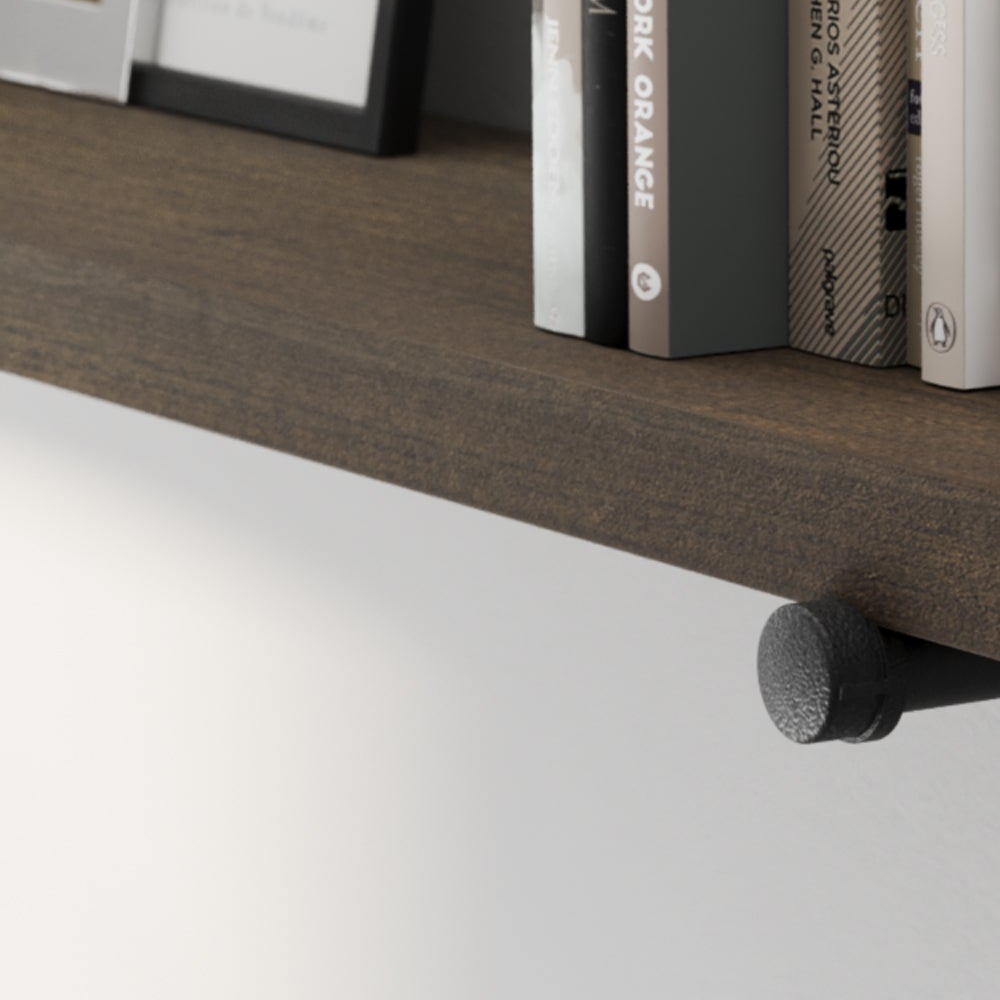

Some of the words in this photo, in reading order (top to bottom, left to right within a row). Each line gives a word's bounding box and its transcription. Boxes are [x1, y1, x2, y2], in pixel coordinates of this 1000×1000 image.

[633, 74, 655, 211] ORANGE
[810, 77, 823, 142] HALL
[826, 62, 842, 187] ASTERIOU
[822, 246, 839, 337] palgrave
